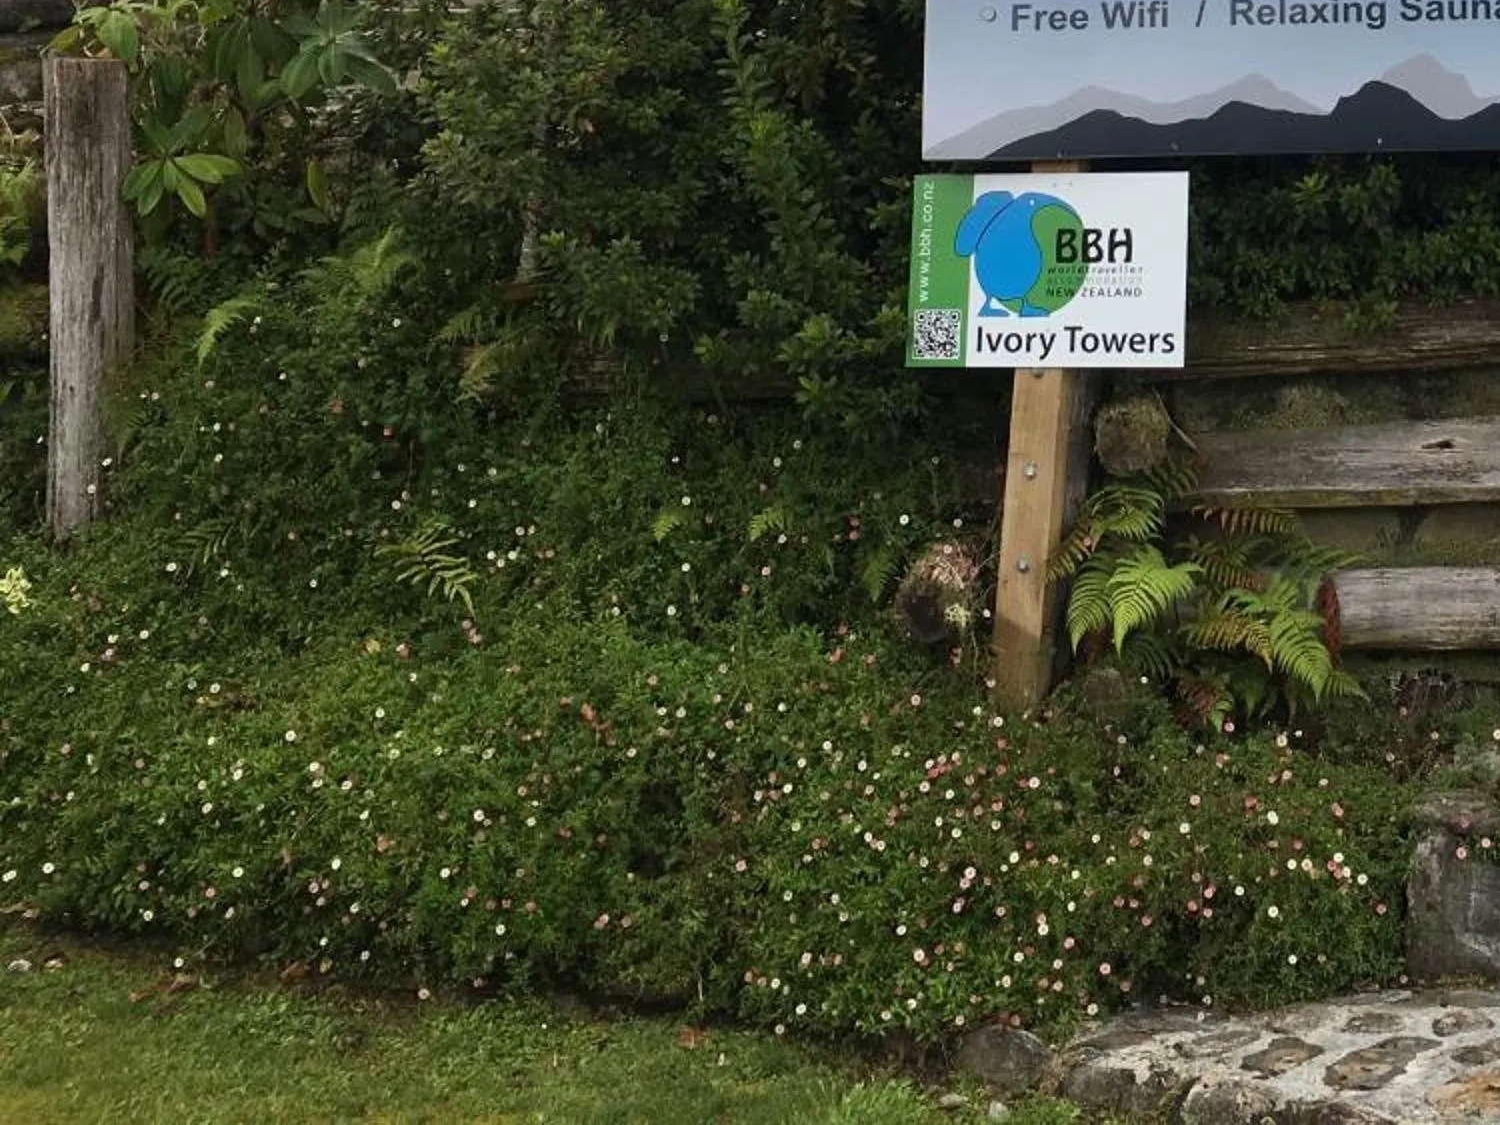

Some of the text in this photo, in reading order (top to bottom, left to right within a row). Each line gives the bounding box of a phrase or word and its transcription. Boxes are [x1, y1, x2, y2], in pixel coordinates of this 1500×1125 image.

[1010, 3, 1089, 32] Free
[1100, 0, 1169, 30] Wifi
[1195, 0, 1206, 28] /
[919, 181, 935, 303] www.bbh.co.nz
[1055, 228, 1133, 264] BBH
[1046, 287, 1143, 297] NEW ZEALAND
[975, 326, 1175, 360] Ivory Towers
